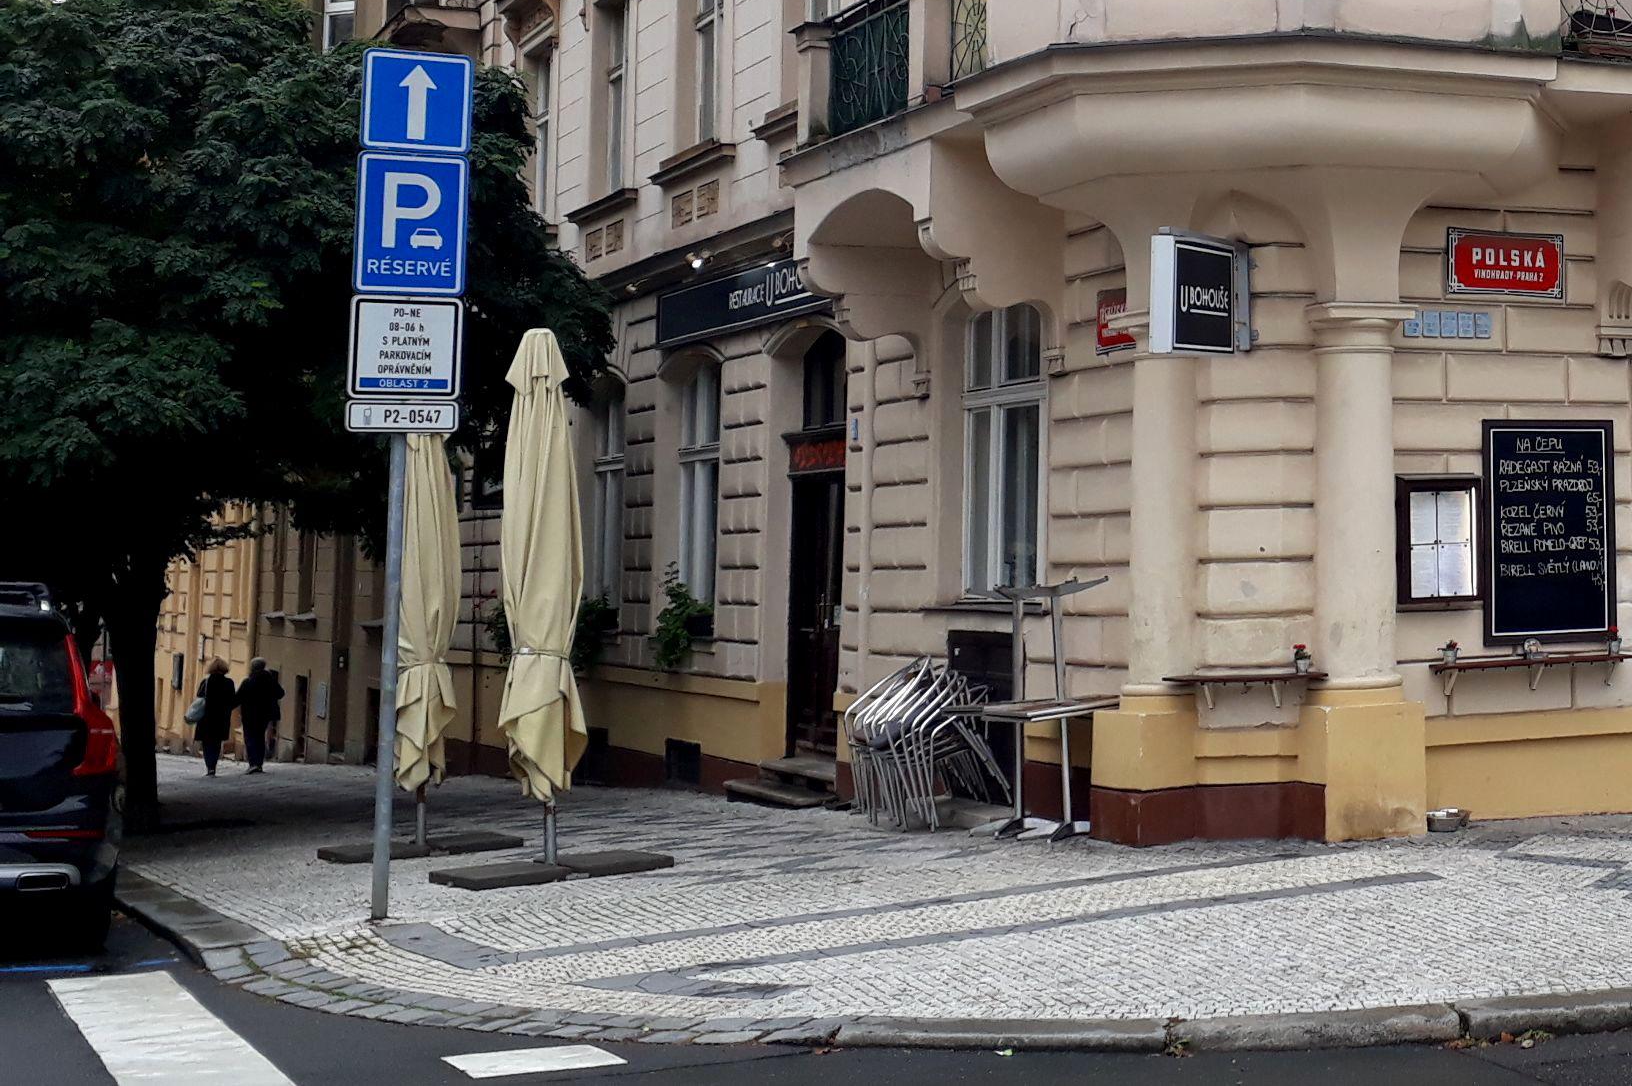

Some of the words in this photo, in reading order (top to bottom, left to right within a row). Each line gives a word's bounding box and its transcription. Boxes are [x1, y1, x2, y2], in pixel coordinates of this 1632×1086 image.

[382, 171, 442, 249] P
[1472, 247, 1545, 268] POLSKÁ
[367, 255, 452, 277] RÉSERVÉ
[1538, 273, 1543, 282] 2
[765, 272, 774, 307] U
[1180, 285, 1189, 313] U
[1189, 285, 1230, 310] BOHOUŠE
[393, 308, 421, 318] PO-NE
[389, 322, 415, 332] 08-06
[419, 322, 424, 332] h
[382, 336, 388, 346] S
[392, 334, 430, 347] PLATNÝM
[379, 350, 432, 361] PARKOVACÍM
[377, 363, 432, 375] OPRÁVNĚNÍM
[379, 378, 418, 388] OBLAST
[423, 379, 429, 389] 2
[383, 409, 442, 425] P2-0547
[1516, 437, 1531, 453] NA
[1535, 436, 1563, 452] ČEPU
[1499, 459, 1550, 475] RADEGAST
[1551, 478, 1593, 492] PRAZDROJ
[1500, 505, 1531, 519] KOZEL
[1543, 522, 1565, 535] PIVO
[1500, 539, 1531, 554] BIRELL
[1500, 563, 1535, 577] BIRELL
